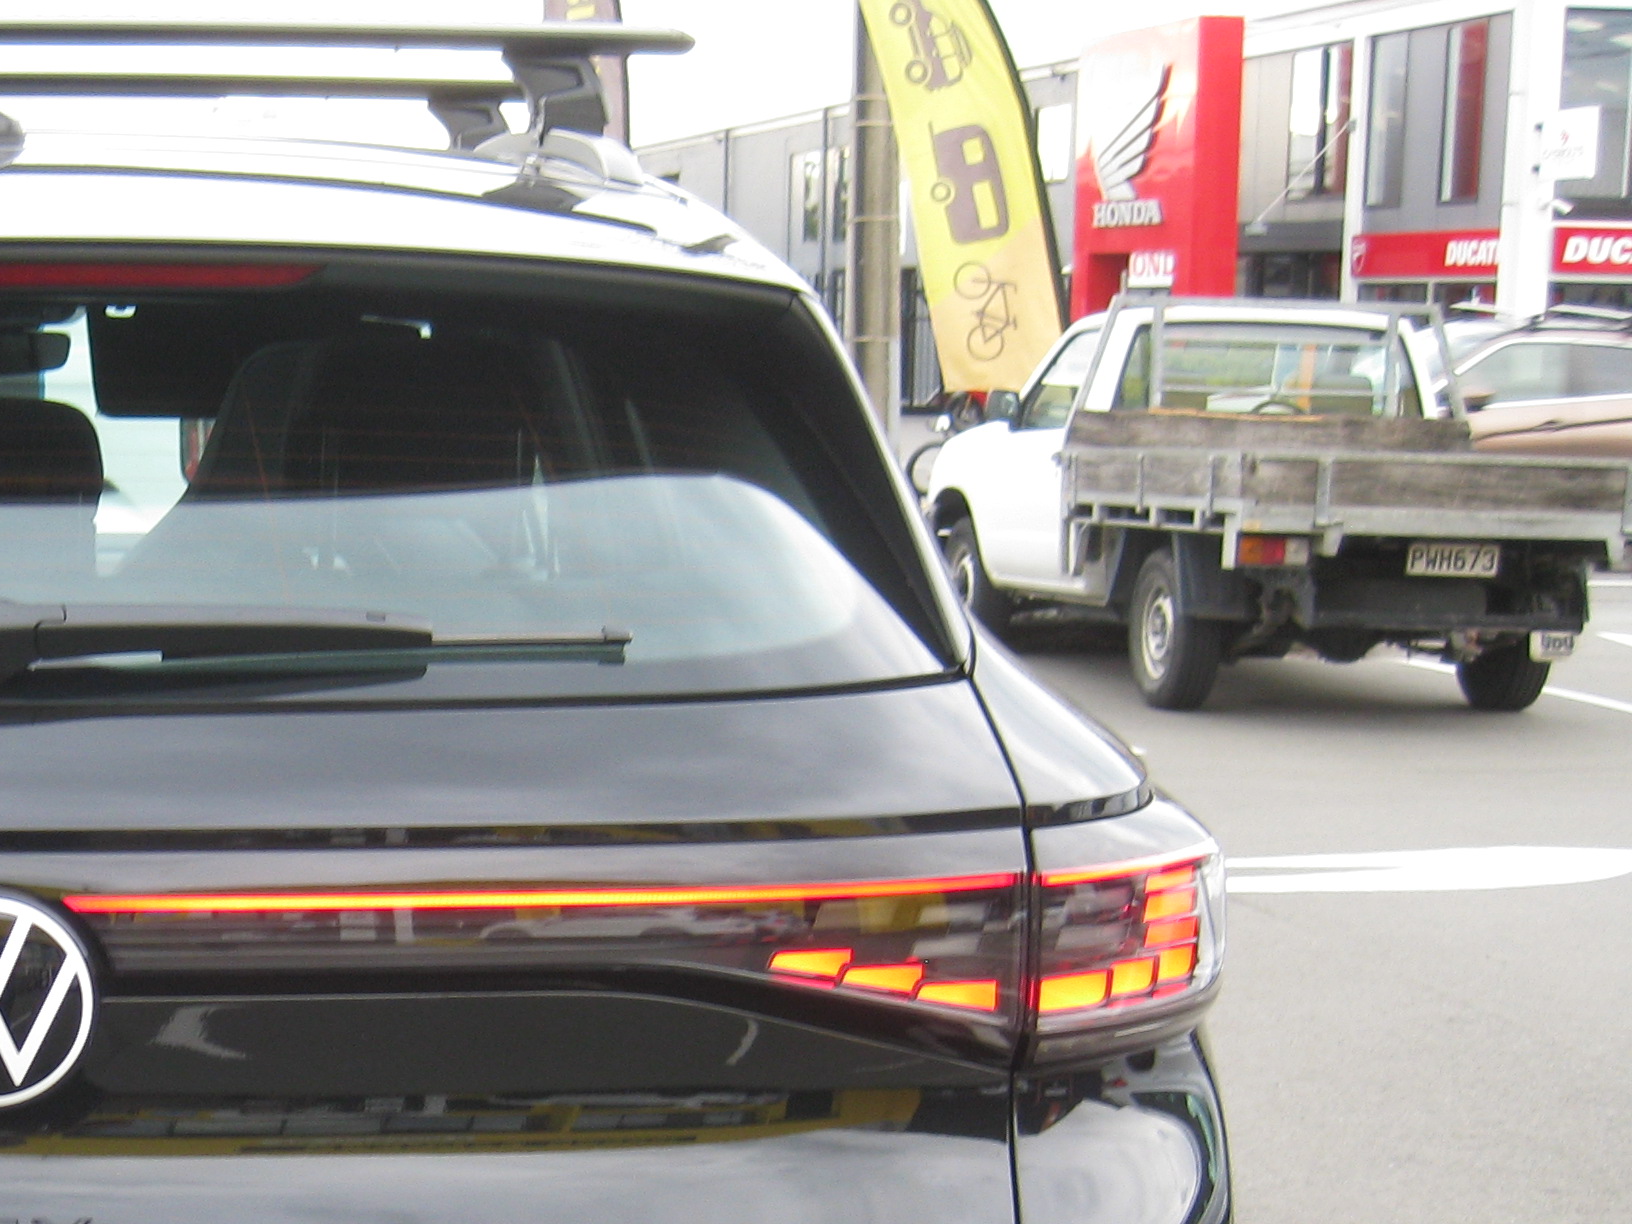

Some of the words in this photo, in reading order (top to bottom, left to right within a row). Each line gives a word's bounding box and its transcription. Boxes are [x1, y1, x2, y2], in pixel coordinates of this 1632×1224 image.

[1091, 199, 1163, 228] HONDA
[1562, 235, 1632, 265] DUC
[1410, 545, 1495, 572] PWH673
